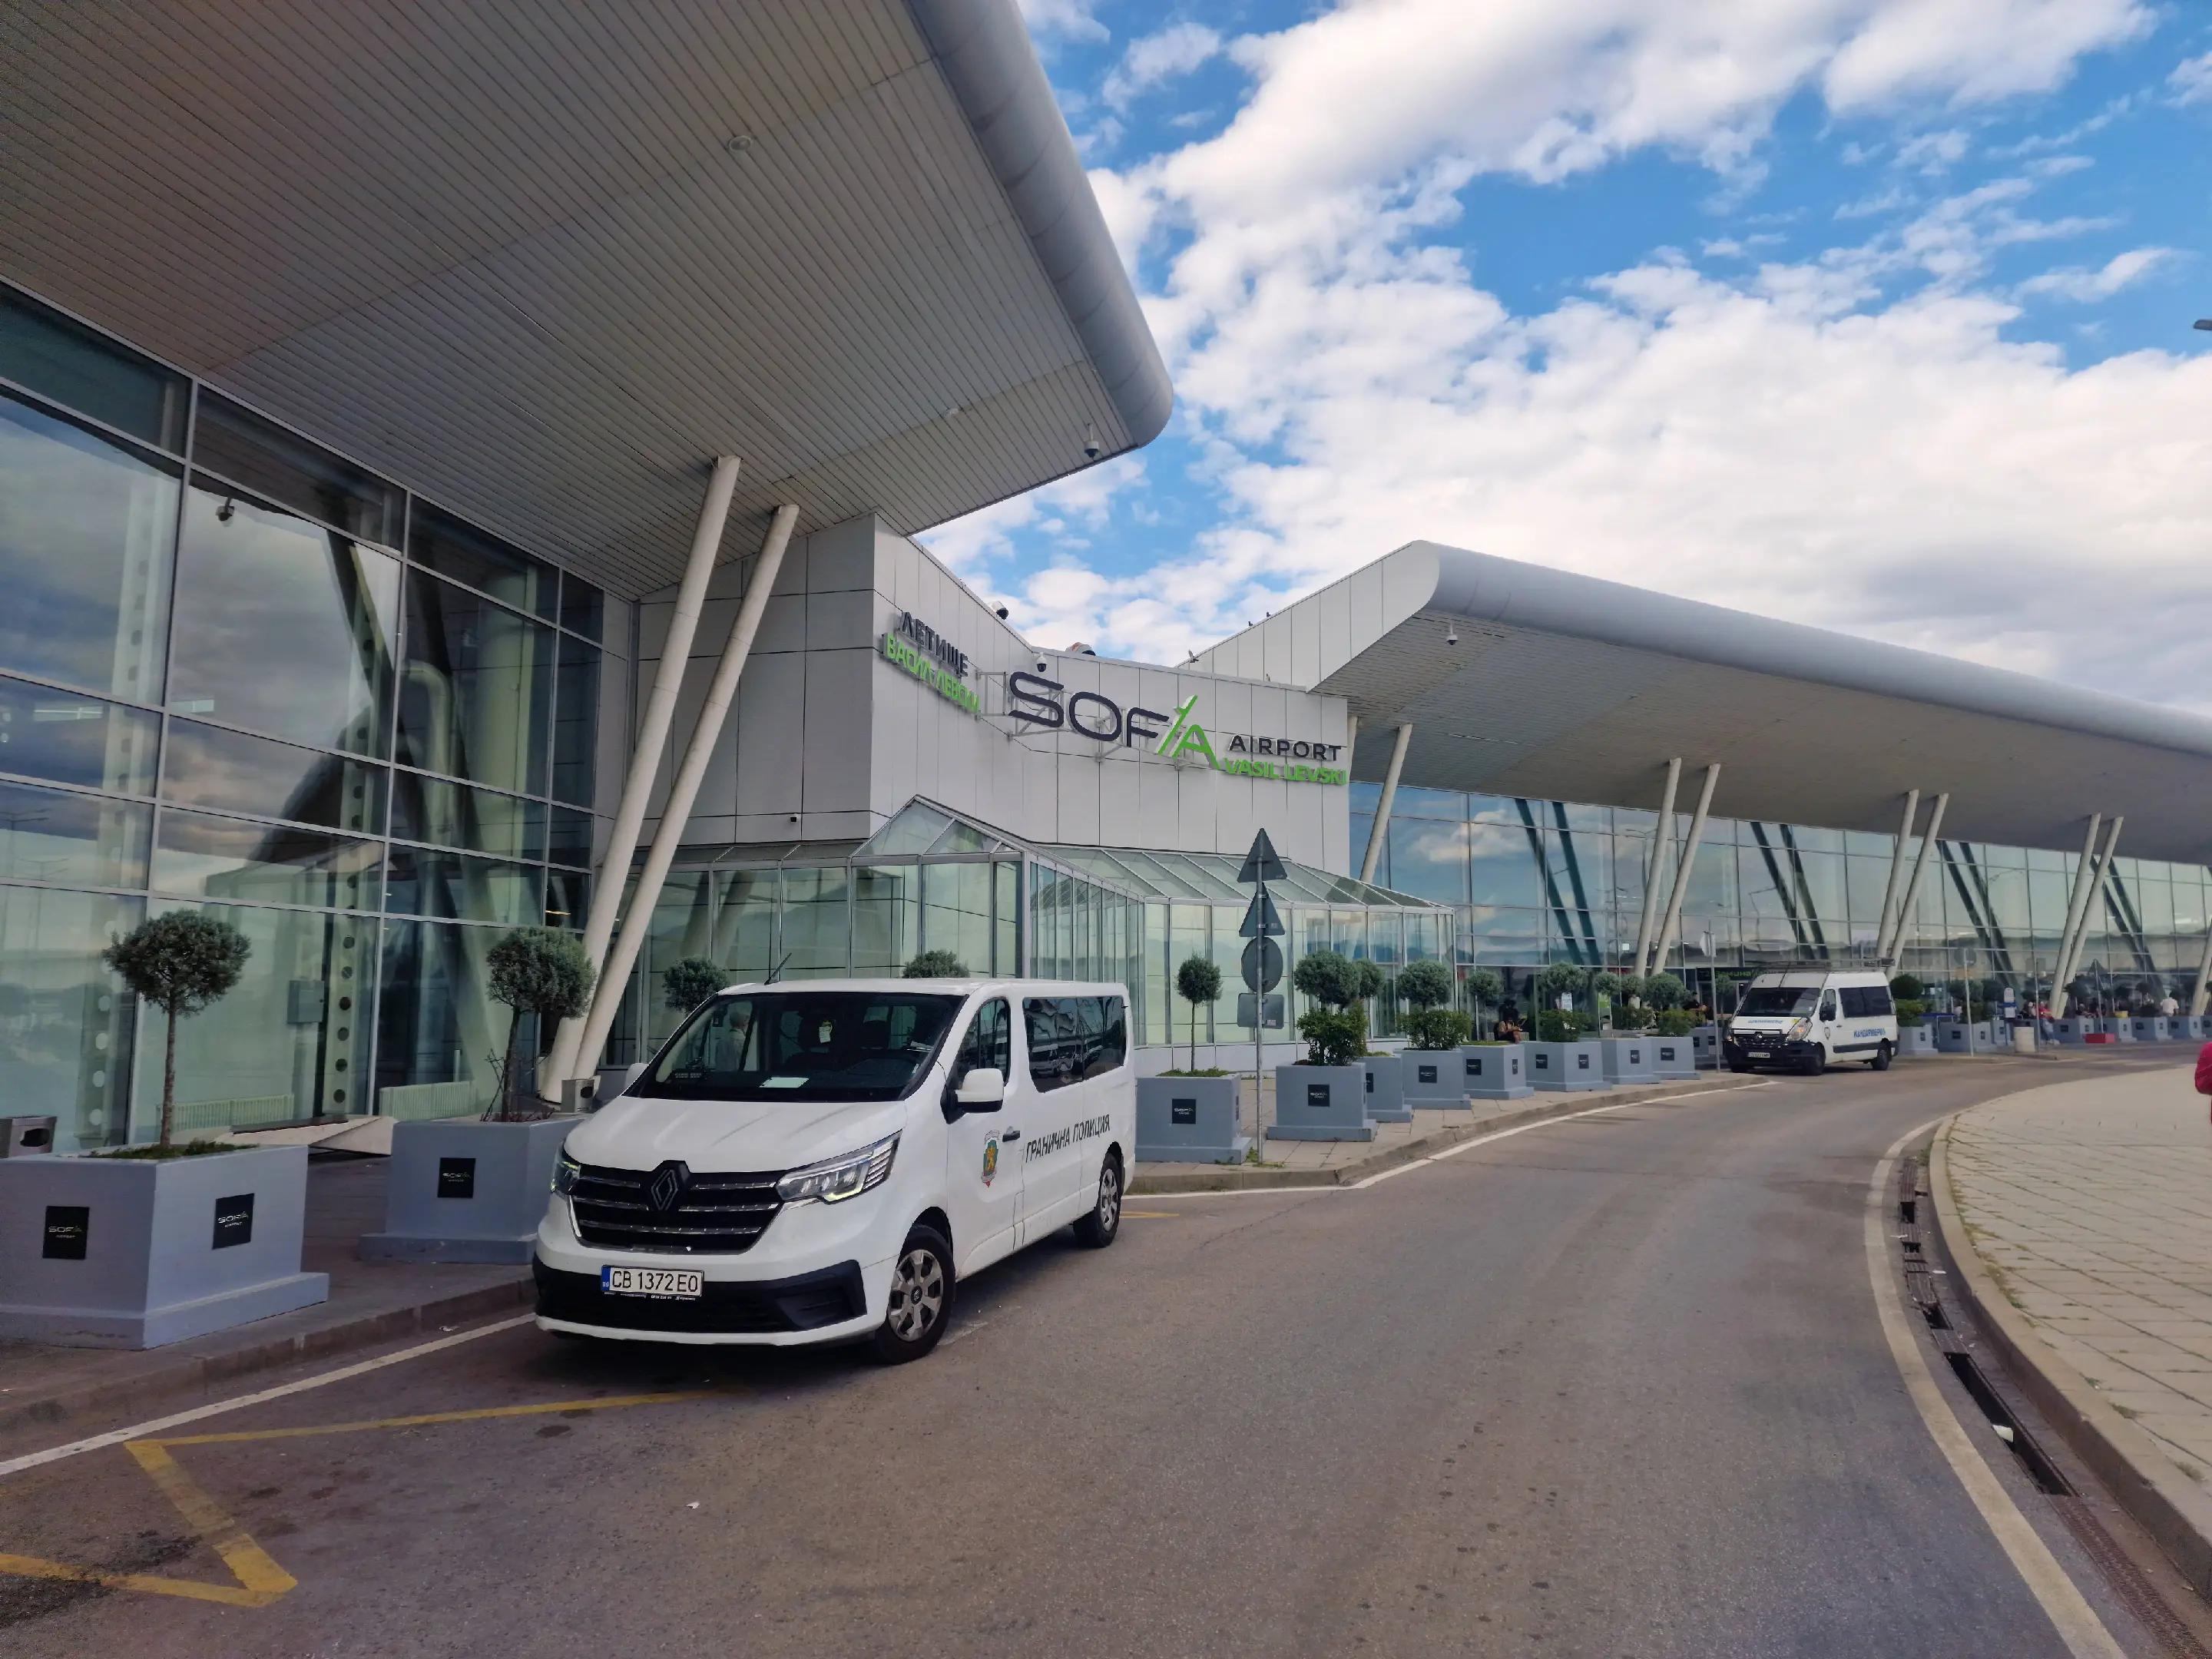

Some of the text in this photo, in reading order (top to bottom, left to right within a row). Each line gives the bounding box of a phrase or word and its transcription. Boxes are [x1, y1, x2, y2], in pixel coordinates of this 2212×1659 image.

[899, 611, 969, 677] ЛЕТИЩЕ
[1008, 671, 1342, 770] SOFIA AIRPORT
[1224, 757, 1349, 786] VASIL LEVSKI
[1025, 1114, 1111, 1163] ГРАНИЧНА ПОЛИЦИЯ
